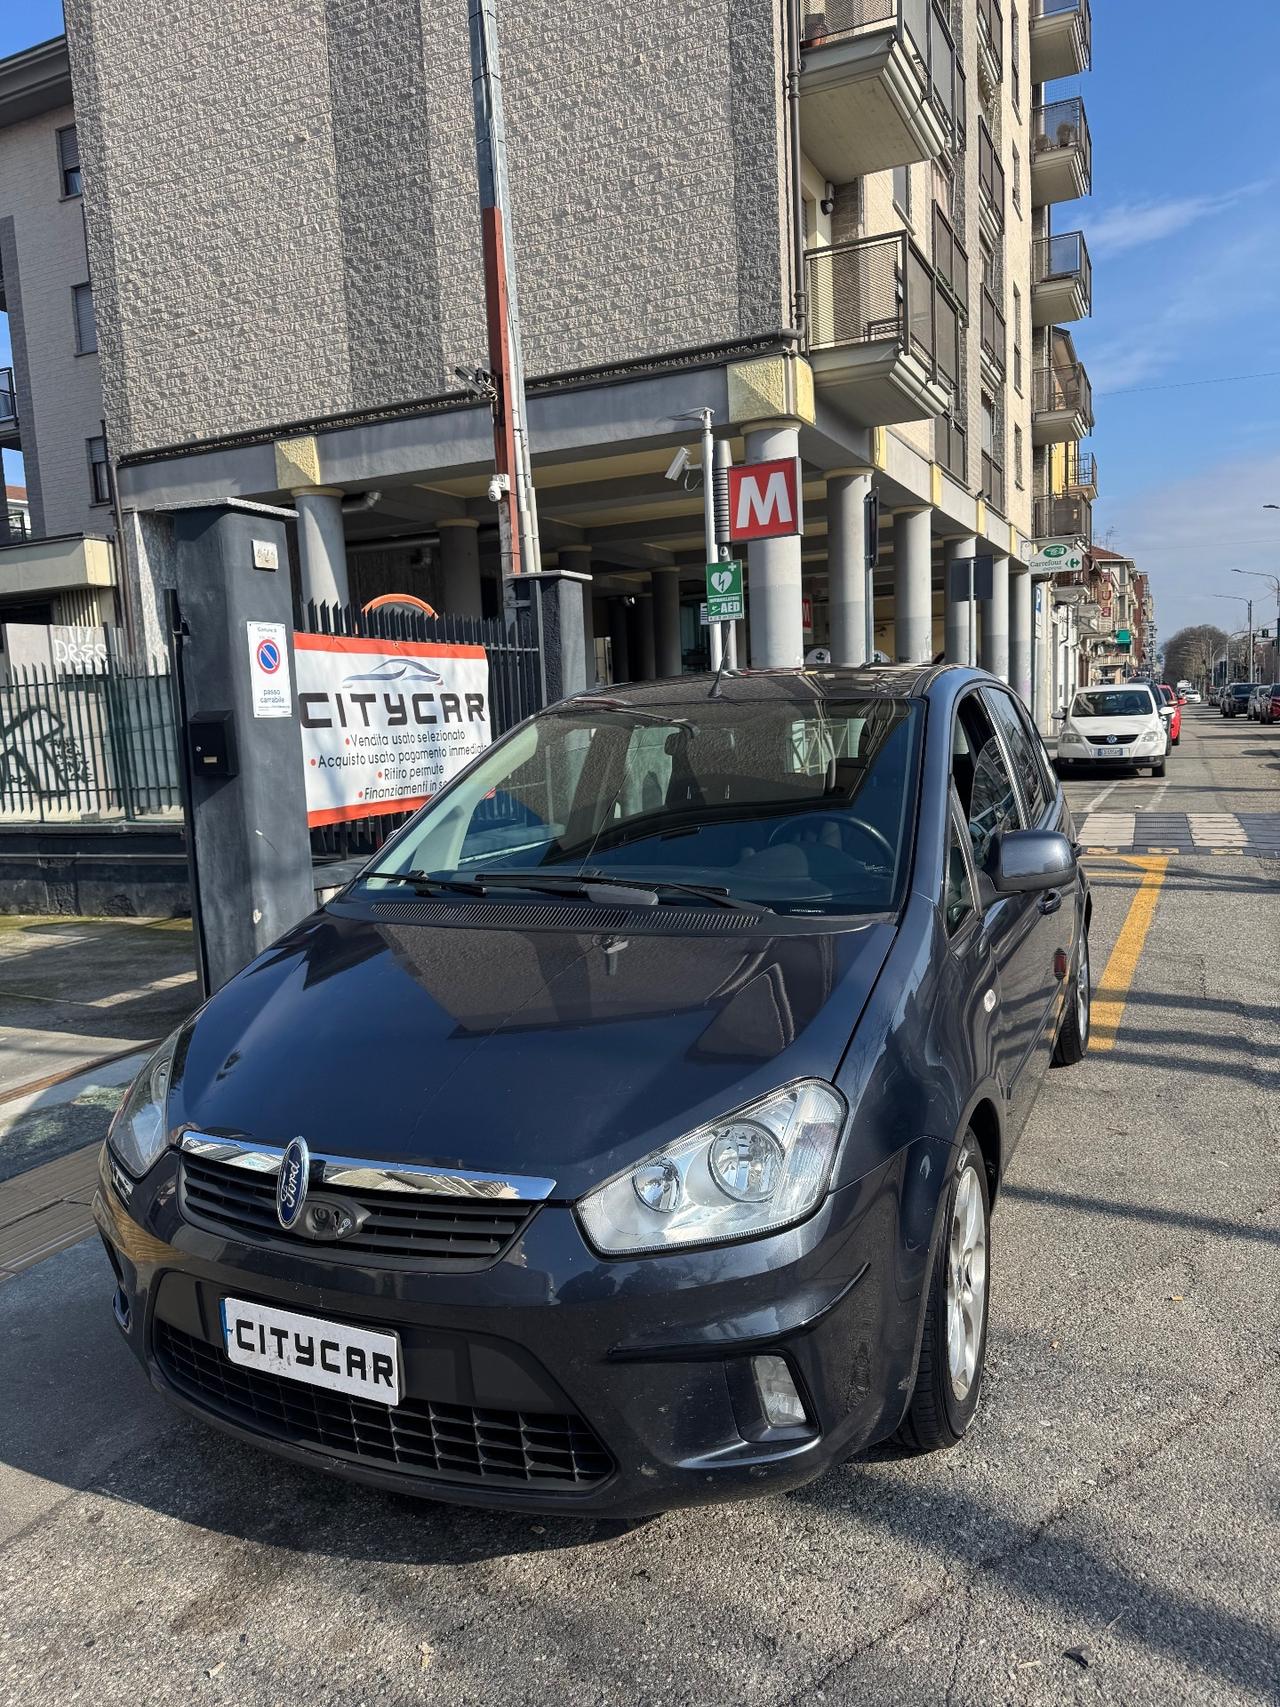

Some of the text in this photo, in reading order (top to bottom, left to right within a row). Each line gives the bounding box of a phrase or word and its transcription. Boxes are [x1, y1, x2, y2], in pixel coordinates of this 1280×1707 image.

[736, 472, 792, 529] M
[720, 602, 740, 613] AED
[298, 692, 486, 728] CITYCAR
[351, 729, 465, 747] Vendita usato selezionato
[318, 752, 366, 769] Acquisto
[368, 752, 395, 764] usato
[398, 746, 447, 763] pagamento
[384, 763, 444, 780] Ritiro permute
[364, 782, 428, 800] Finanziamenti
[429, 779, 437, 791] in
[280, 1160, 300, 1208] Ford
[235, 1319, 395, 1388] CITYCAR
